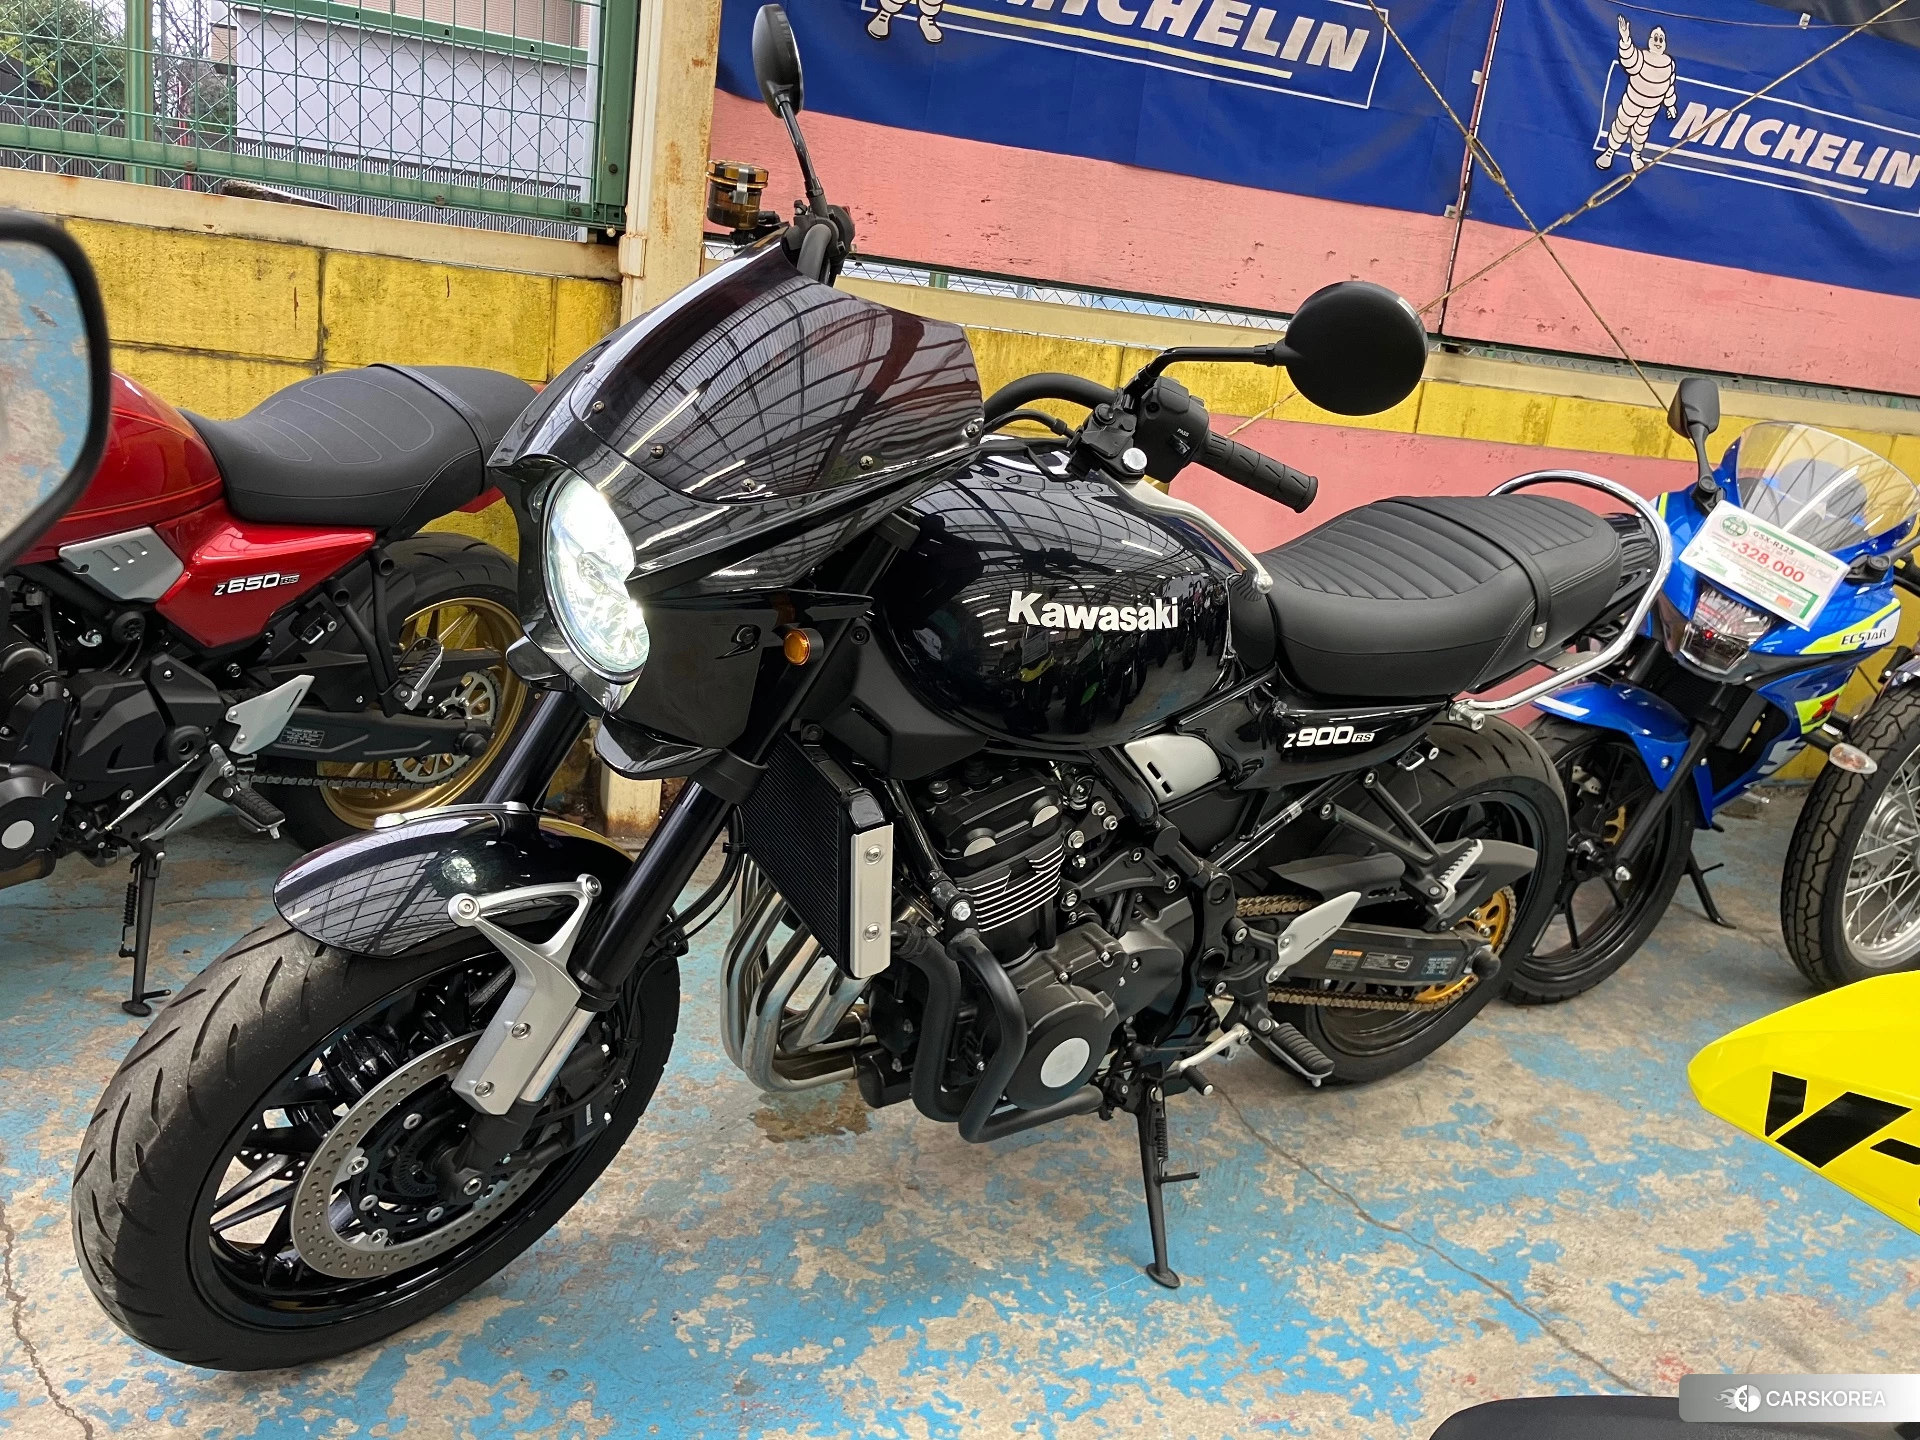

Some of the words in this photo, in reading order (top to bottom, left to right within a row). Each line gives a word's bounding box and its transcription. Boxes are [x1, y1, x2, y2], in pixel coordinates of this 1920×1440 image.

[1669, 101, 1920, 189] MICHELIN
[1008, 590, 1178, 632] Kawasaki
[1841, 628, 1887, 645] ECSTAR
